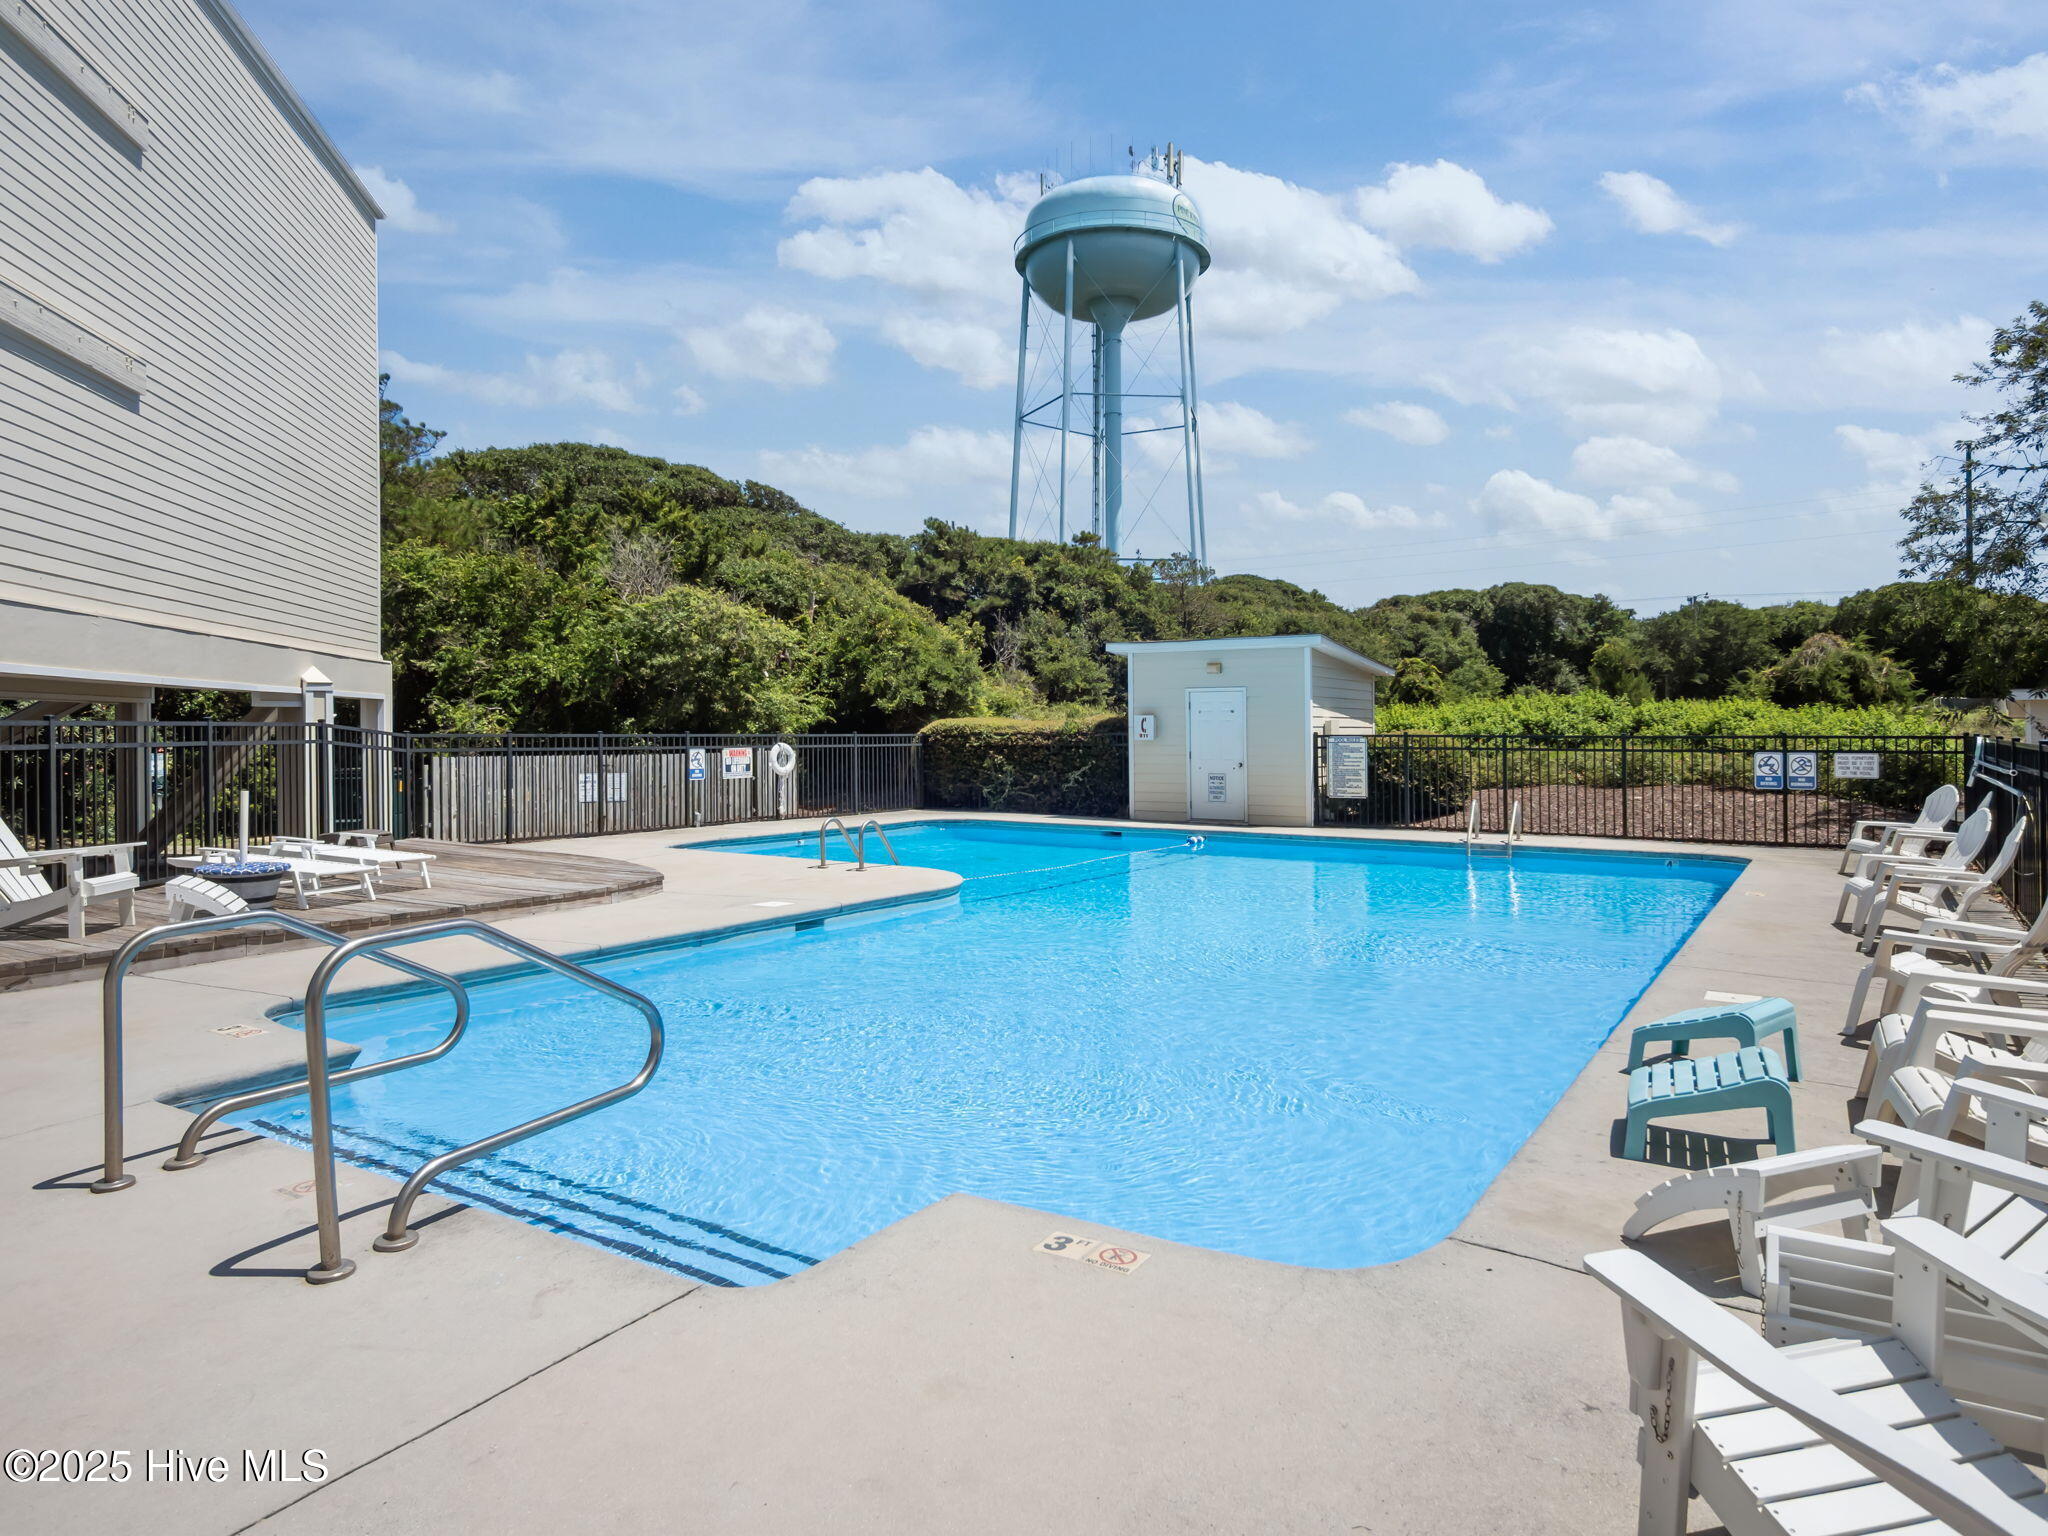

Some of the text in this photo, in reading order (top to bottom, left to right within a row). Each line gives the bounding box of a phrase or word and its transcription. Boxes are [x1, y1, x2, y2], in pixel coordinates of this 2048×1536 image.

[1043, 1235, 1094, 1252] 3 FT
[1099, 1261, 1130, 1273] DIVING
